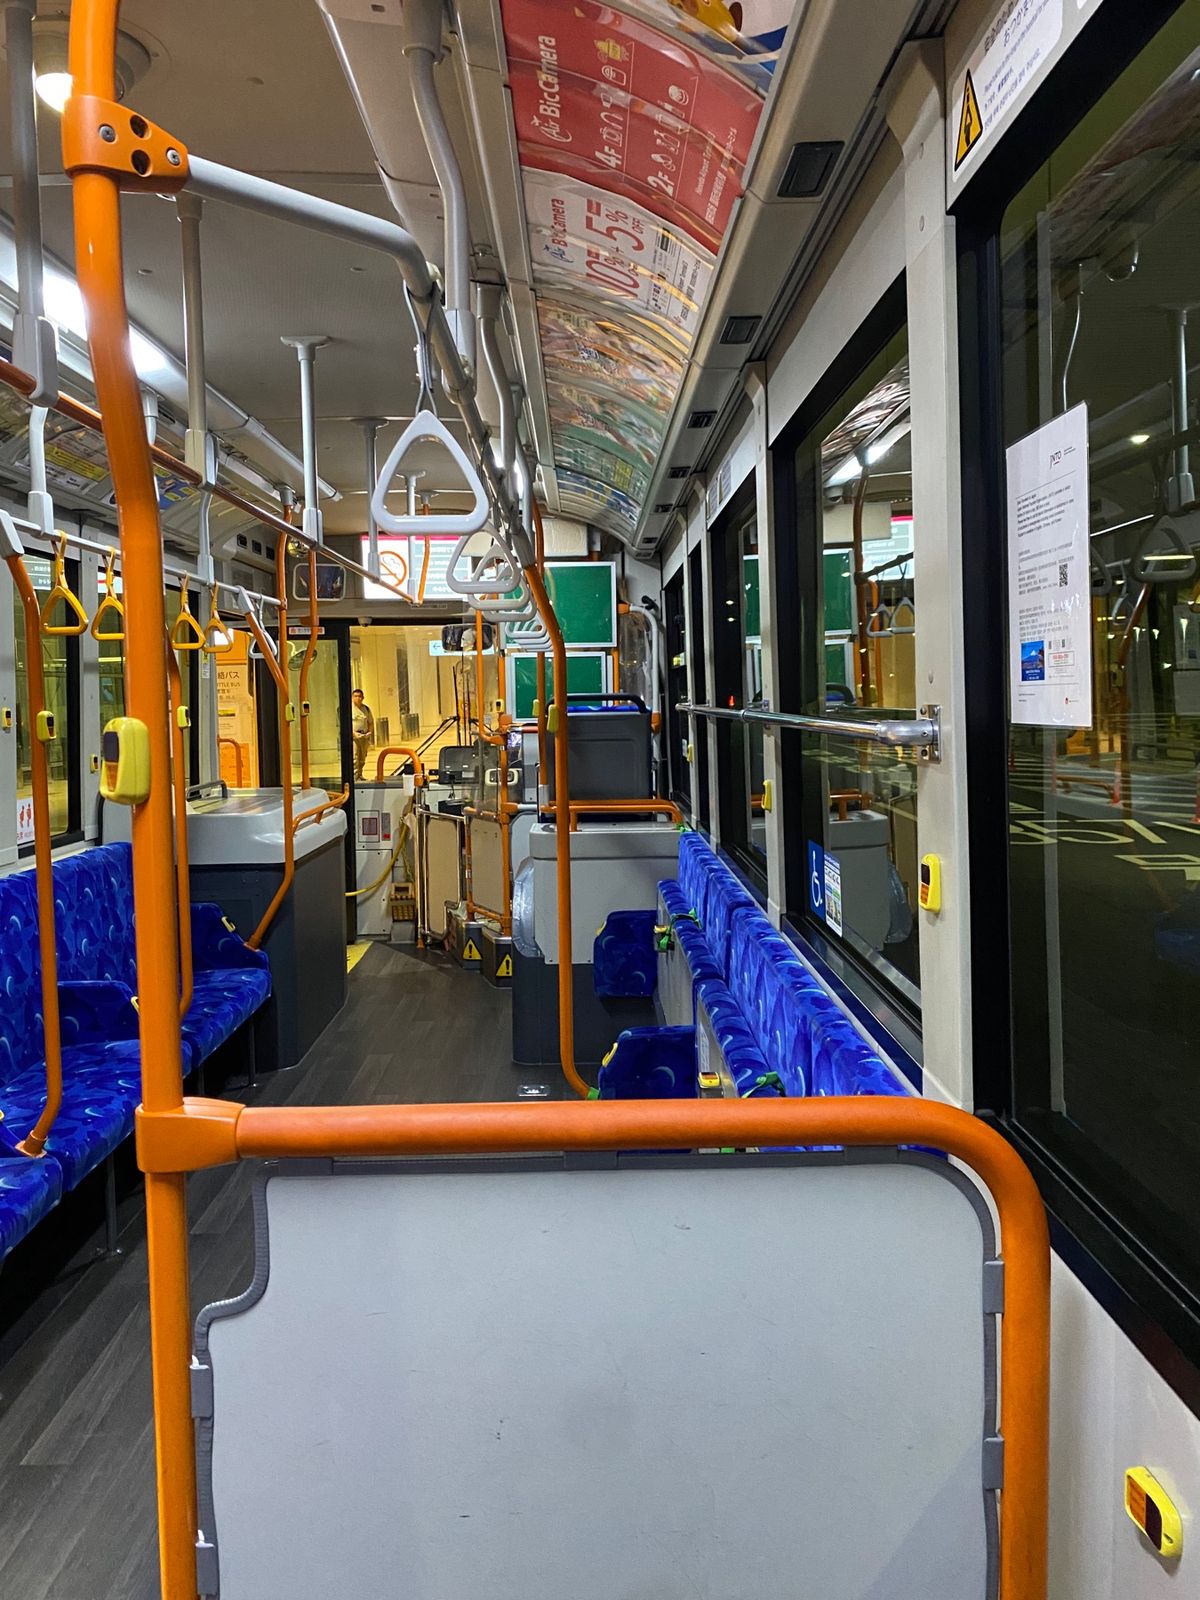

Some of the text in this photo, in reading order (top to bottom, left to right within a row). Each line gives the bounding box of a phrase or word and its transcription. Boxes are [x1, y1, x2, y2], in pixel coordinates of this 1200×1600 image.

[538, 35, 560, 118] BicCamera
[595, 145, 623, 169] 4F
[647, 170, 675, 197] 2F
